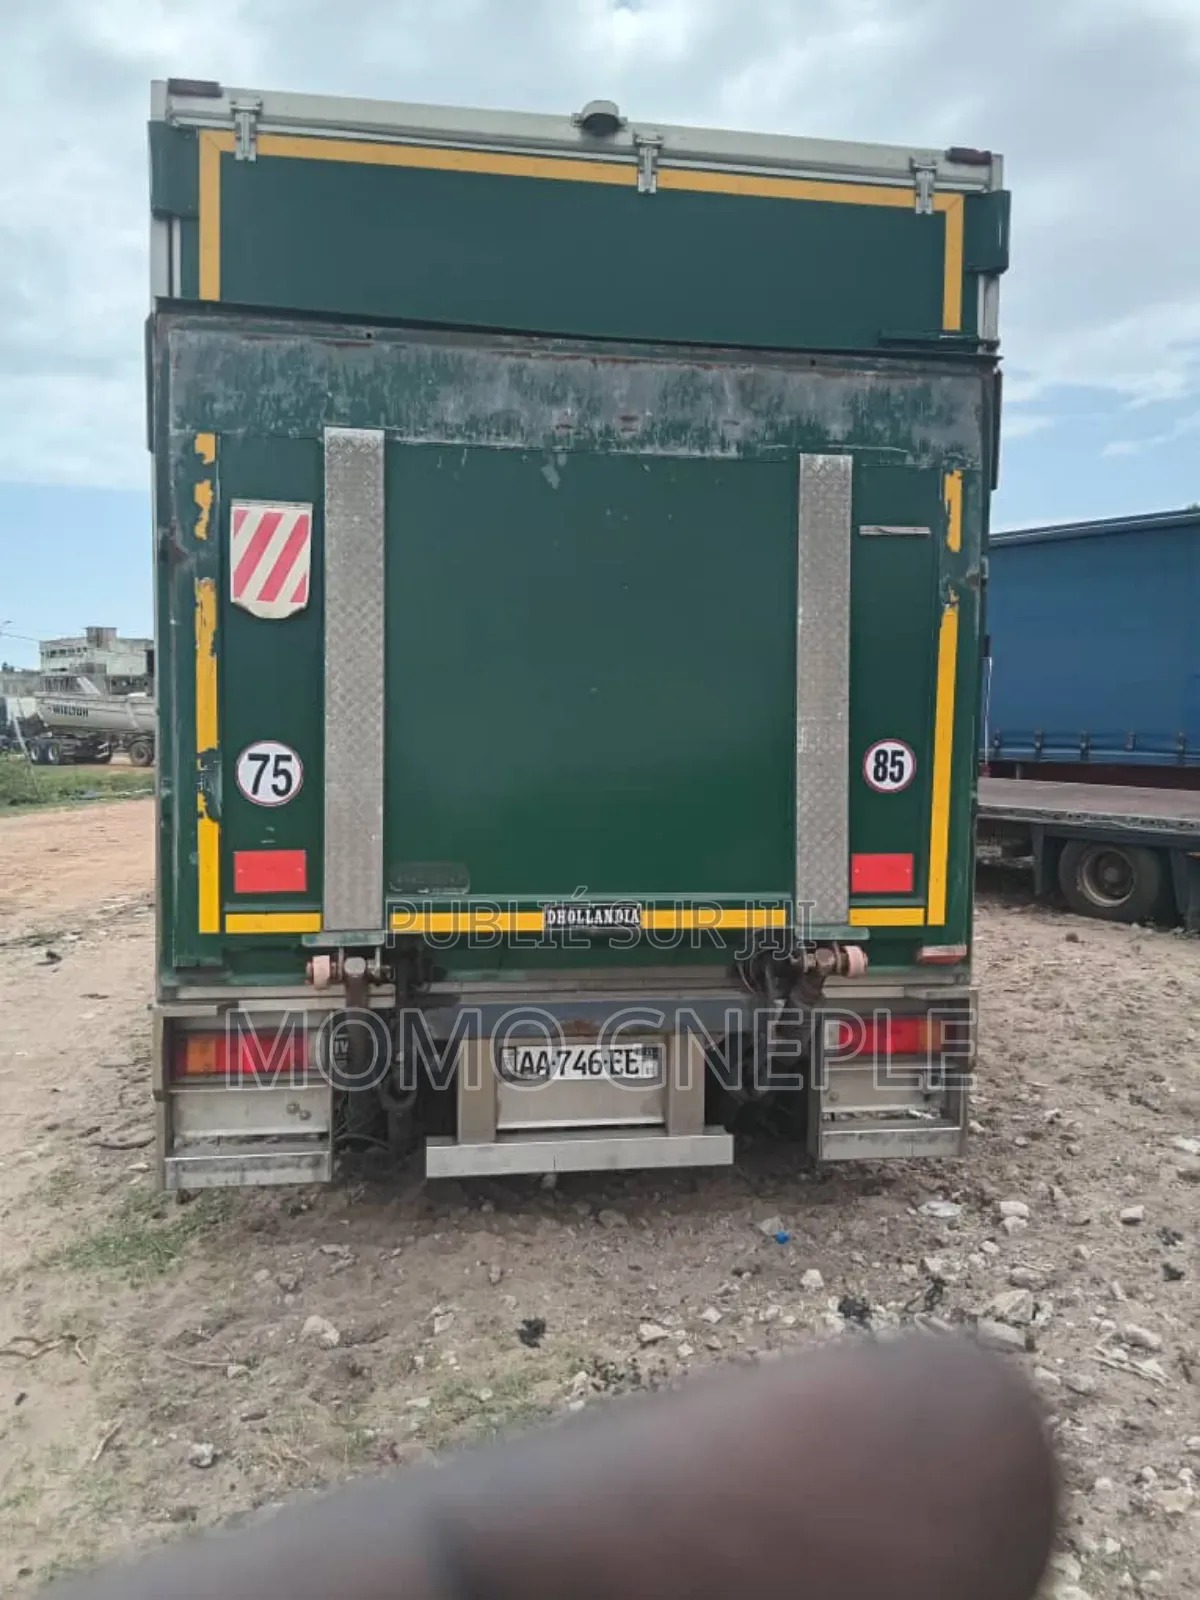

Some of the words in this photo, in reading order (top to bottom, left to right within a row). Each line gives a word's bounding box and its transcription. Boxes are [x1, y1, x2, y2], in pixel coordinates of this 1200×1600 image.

[248, 752, 293, 797] 75
[873, 749, 905, 783] 85
[547, 907, 641, 925] DHOLLANDIA
